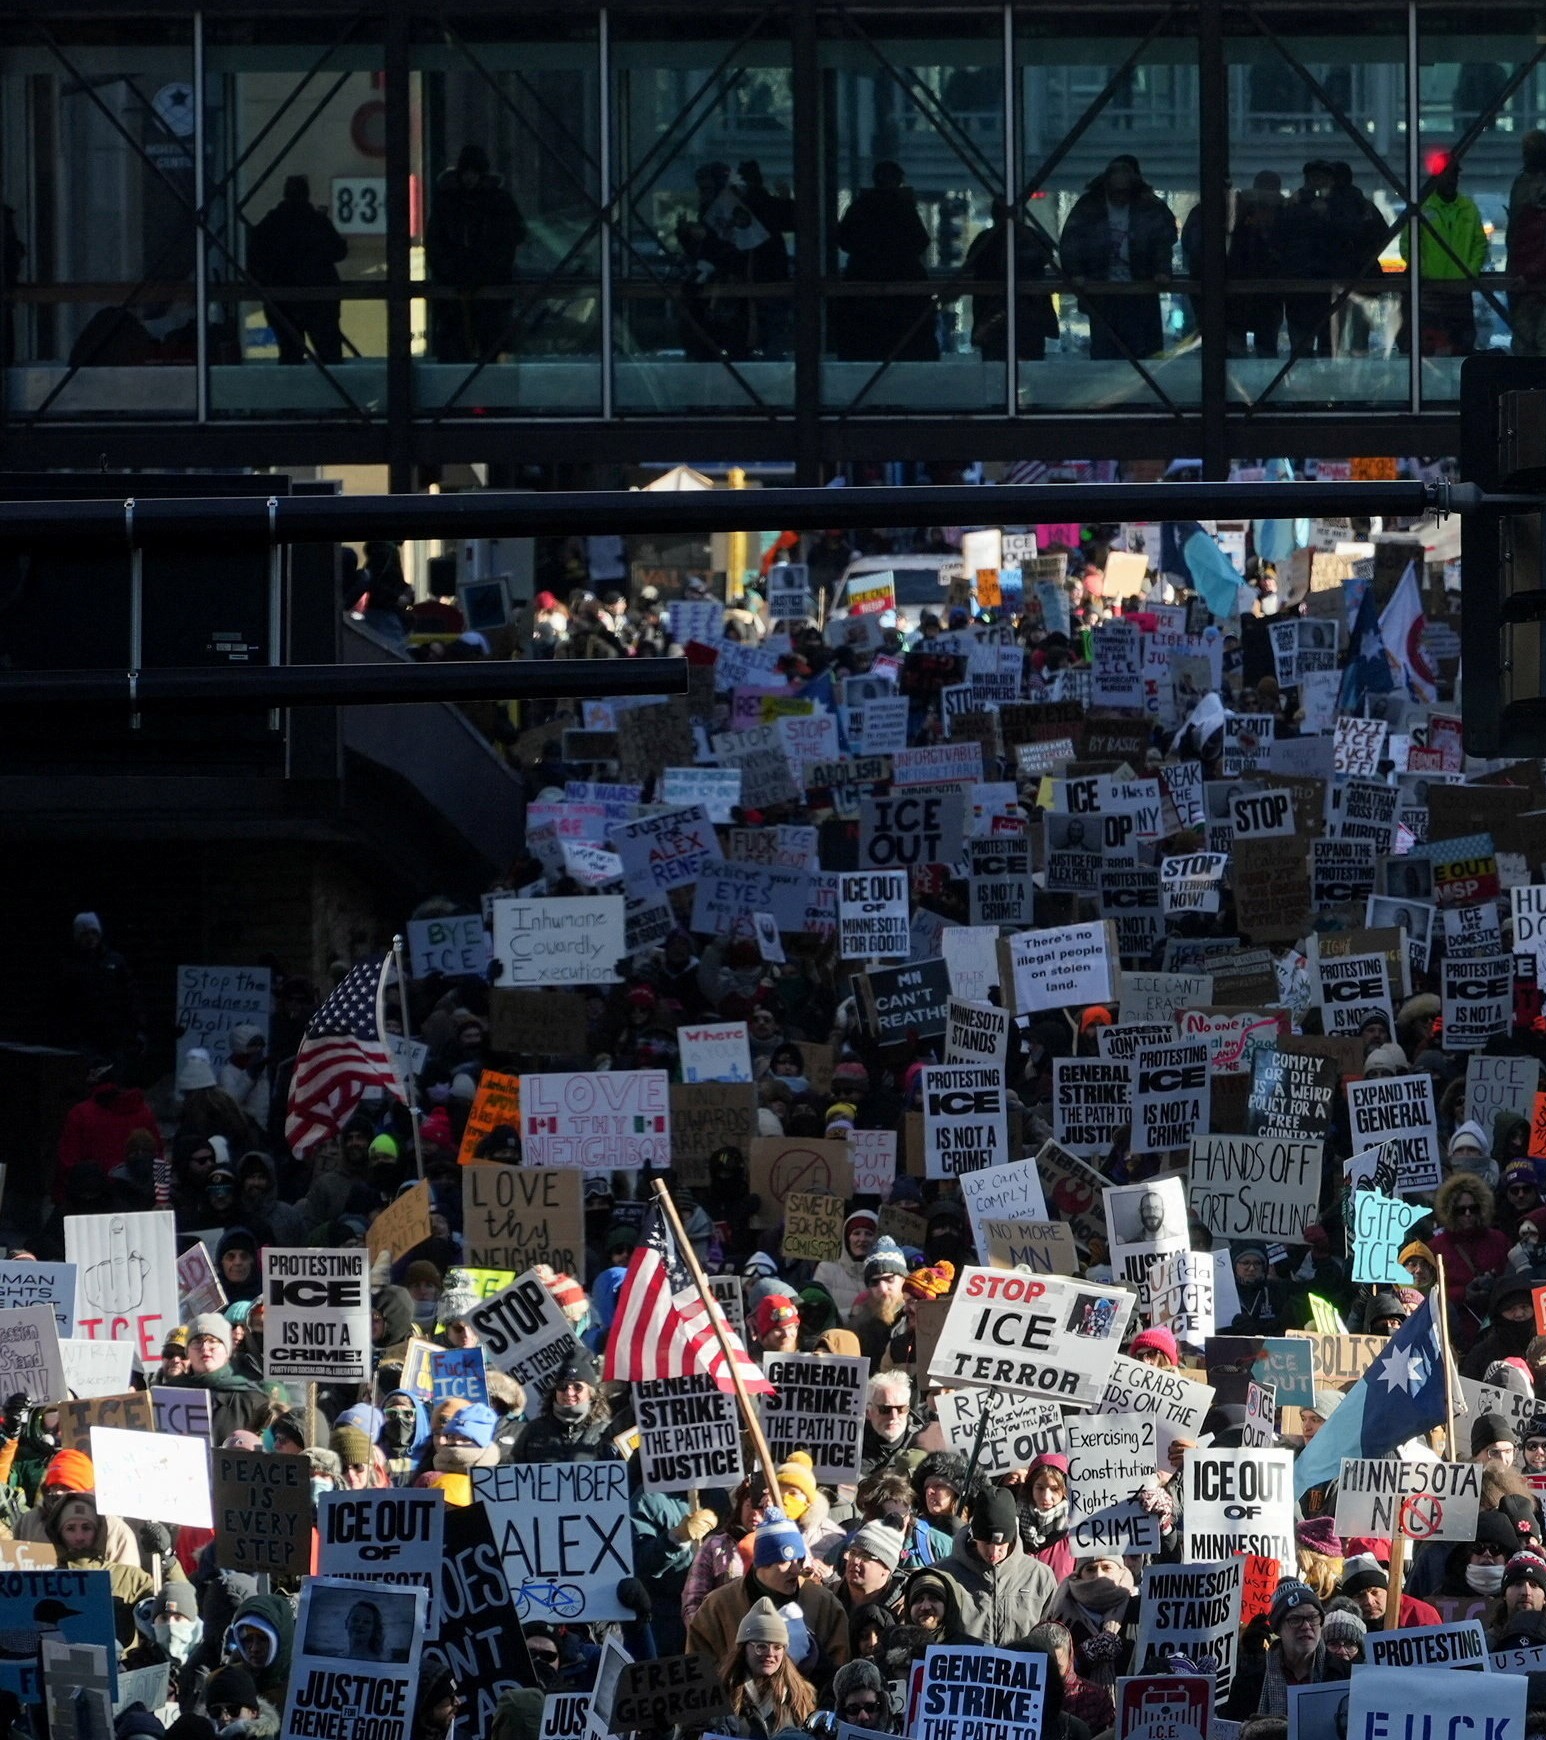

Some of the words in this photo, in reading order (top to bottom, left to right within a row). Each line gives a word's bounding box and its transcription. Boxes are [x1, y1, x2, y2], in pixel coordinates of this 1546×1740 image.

[875, 799, 941, 832] ICE
[1235, 795, 1288, 832] STOP
[868, 834, 941, 864] OUT
[1165, 856, 1218, 877] STOP
[843, 877, 868, 901] ICE
[871, 876, 901, 899] OUT
[862, 903, 886, 912] OF
[843, 918, 906, 933] MINNESOTA
[870, 935, 908, 951] GOOD!
[1024, 933, 1072, 948] There's
[1077, 931, 1092, 940] no
[1018, 951, 1055, 965] illegal
[1059, 946, 1103, 962] people
[1446, 959, 1509, 977] PROTESTING
[898, 971, 922, 986] MN
[1032, 969, 1046, 979] on
[1051, 963, 1091, 976] stolen
[1046, 980, 1077, 991] land.
[1447, 980, 1509, 999] ICE
[1272, 1052, 1323, 1071] COMPLY
[927, 1070, 999, 1088] PROTESTING
[1265, 1069, 1284, 1082] OR
[1291, 1070, 1313, 1084] DIE
[529, 1075, 666, 1114] LOVE
[930, 1093, 999, 1115] ICE
[1288, 1086, 1331, 1102] WEIRD
[1284, 1100, 1311, 1116] FOR
[1356, 1105, 1431, 1133] GENERAL
[573, 1116, 626, 1133] THY
[1192, 1145, 1268, 1183] HANDS
[1274, 1142, 1318, 1183] OFF
[472, 1172, 559, 1207] LOVE
[788, 1198, 822, 1216] SAVE
[1357, 1195, 1412, 1238] GTFO
[814, 1219, 838, 1235] FOR
[989, 1225, 1013, 1241] NO
[1019, 1224, 1061, 1242] MORE
[269, 1254, 362, 1276] PROTESTING
[1356, 1240, 1396, 1281] ICE
[271, 1280, 361, 1306] ICE
[966, 1275, 1046, 1303] STOP
[472, 1281, 549, 1352] STOP
[974, 1308, 1056, 1350] ICE
[283, 1322, 296, 1343] IS
[300, 1322, 334, 1344] NOT
[337, 1322, 350, 1345] A
[270, 1349, 362, 1363] CRIME!
[1261, 1354, 1299, 1372] ICE
[769, 1362, 858, 1388] GENERAL
[954, 1354, 1080, 1394] TERROR
[1263, 1374, 1310, 1392] OUT
[433, 1377, 479, 1398] ICE
[154, 1406, 208, 1435] ICE
[641, 1399, 733, 1429] STRIKE:
[766, 1417, 795, 1440] THE
[799, 1420, 834, 1441] PATH
[838, 1426, 855, 1442] TO
[1069, 1429, 1138, 1452] Exercising
[1142, 1423, 1154, 1445] 2
[221, 1458, 297, 1485] PEACE
[647, 1448, 739, 1483] JUSTICE
[470, 1464, 626, 1501] REMEMBER
[1194, 1462, 1234, 1501] ICE
[1240, 1462, 1284, 1501] OUT
[1342, 1463, 1476, 1497] MINNESOTA
[1072, 1490, 1118, 1515] Rights
[1224, 1506, 1261, 1519] OF
[225, 1510, 297, 1534] EVERY
[327, 1503, 372, 1544] ICE
[376, 1503, 431, 1542] OUT
[1076, 1516, 1153, 1548] CRIME
[502, 1515, 631, 1576] ALEX
[1148, 1565, 1240, 1600] MINNESOTA
[1156, 1595, 1231, 1629] STANDS
[1374, 1633, 1481, 1665] PROTESTING
[930, 1653, 1039, 1690] GENERAL
[297, 1672, 408, 1709] JUSTICE
[924, 1682, 1038, 1722] STRIKE:
